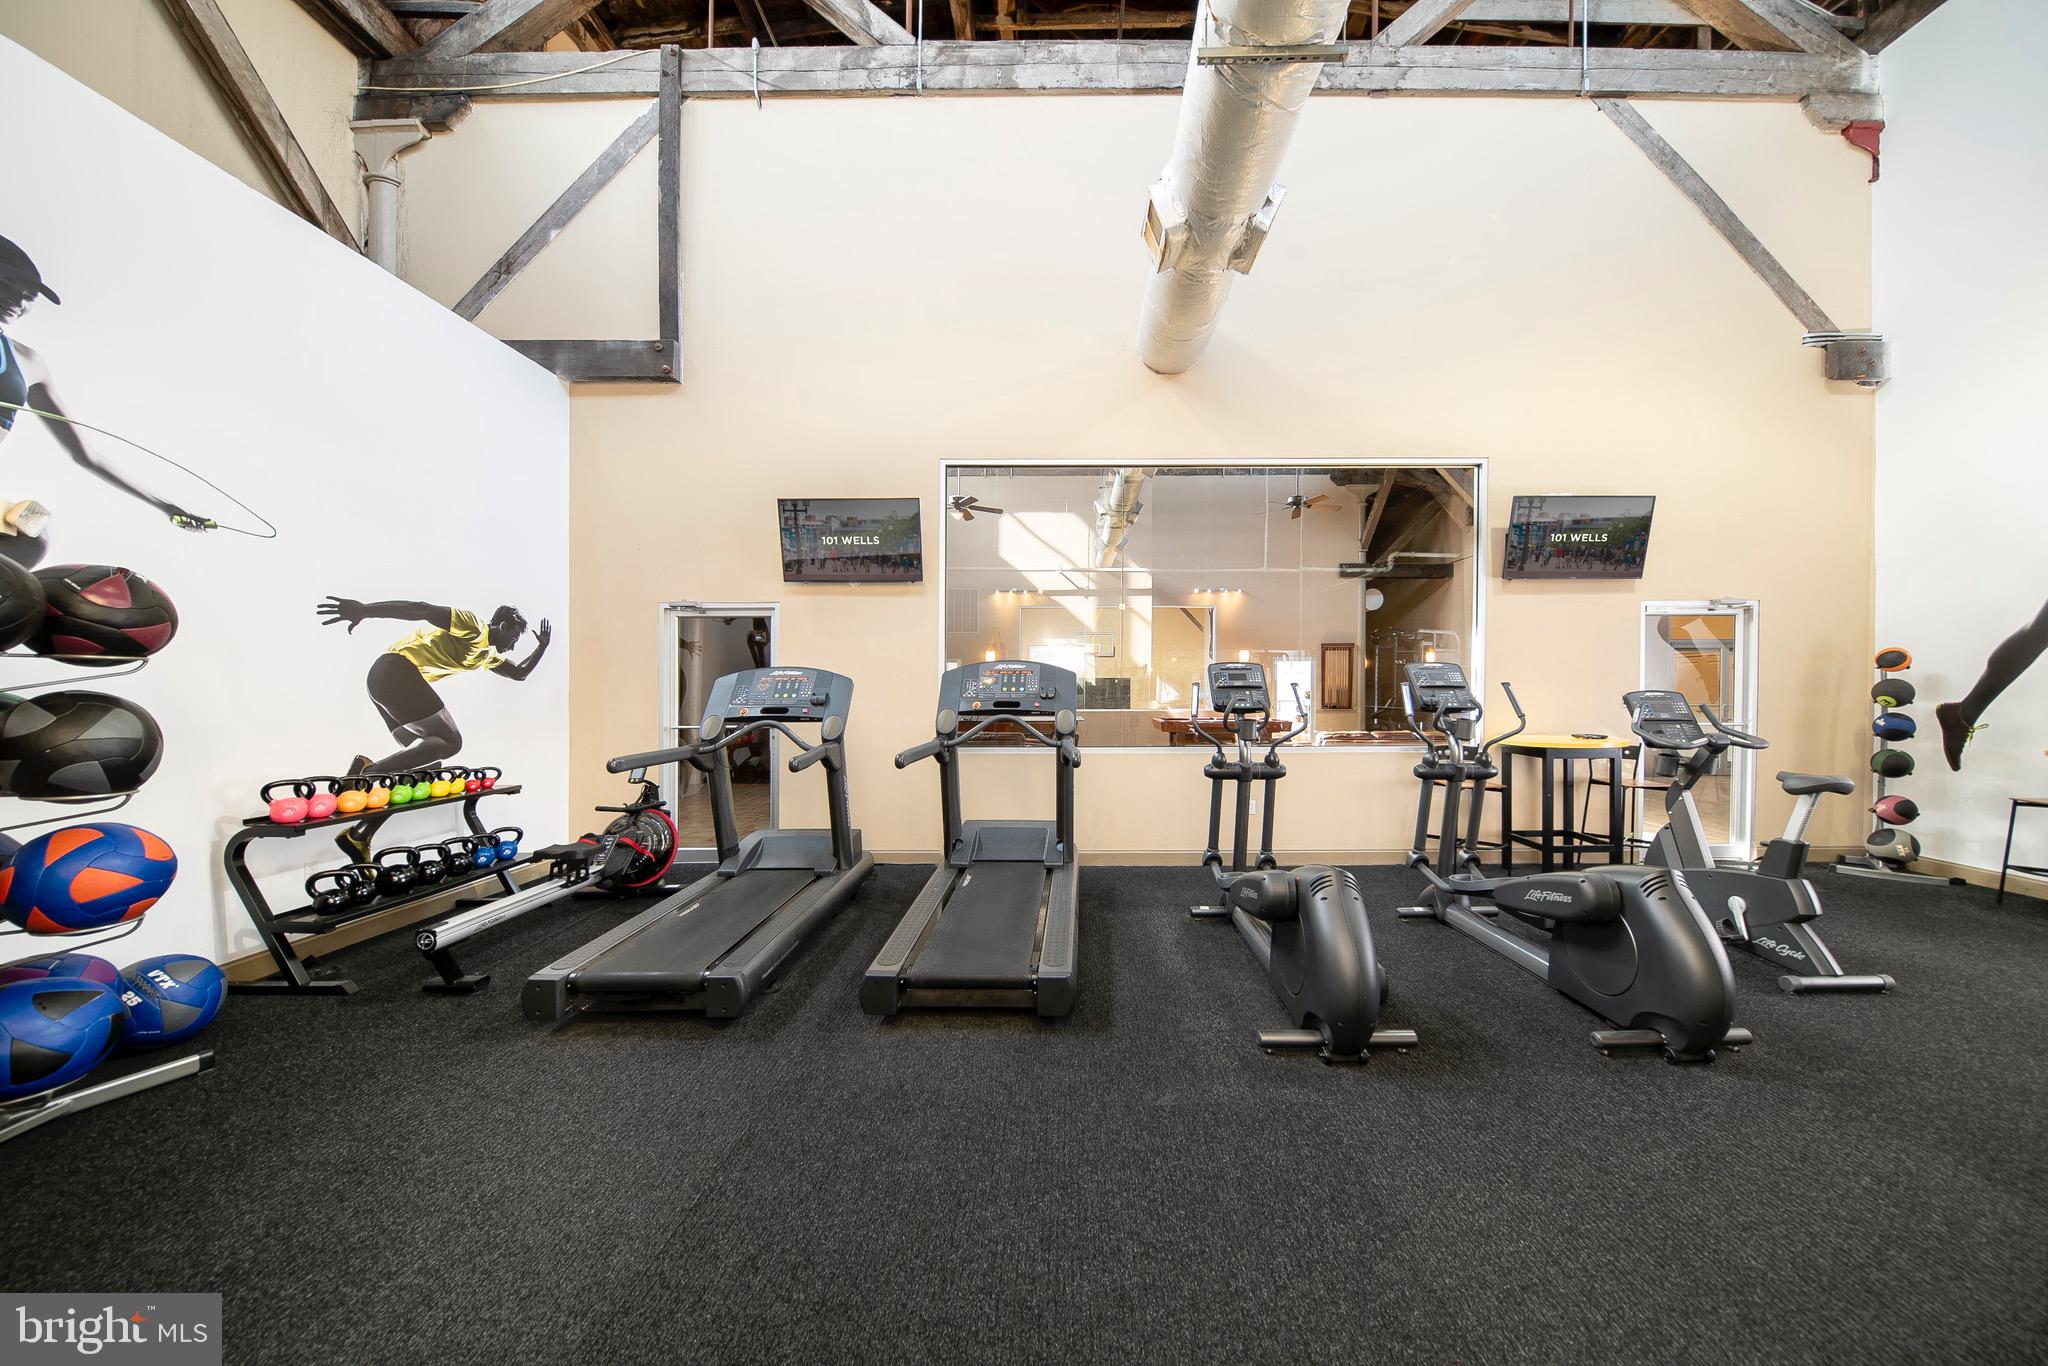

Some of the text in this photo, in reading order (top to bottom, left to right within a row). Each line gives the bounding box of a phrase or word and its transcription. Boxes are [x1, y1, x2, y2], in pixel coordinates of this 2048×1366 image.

[821, 535, 880, 545] 101 WELLS
[1550, 533, 1608, 542] 101 WELLS
[121, 990, 143, 1007] 25
